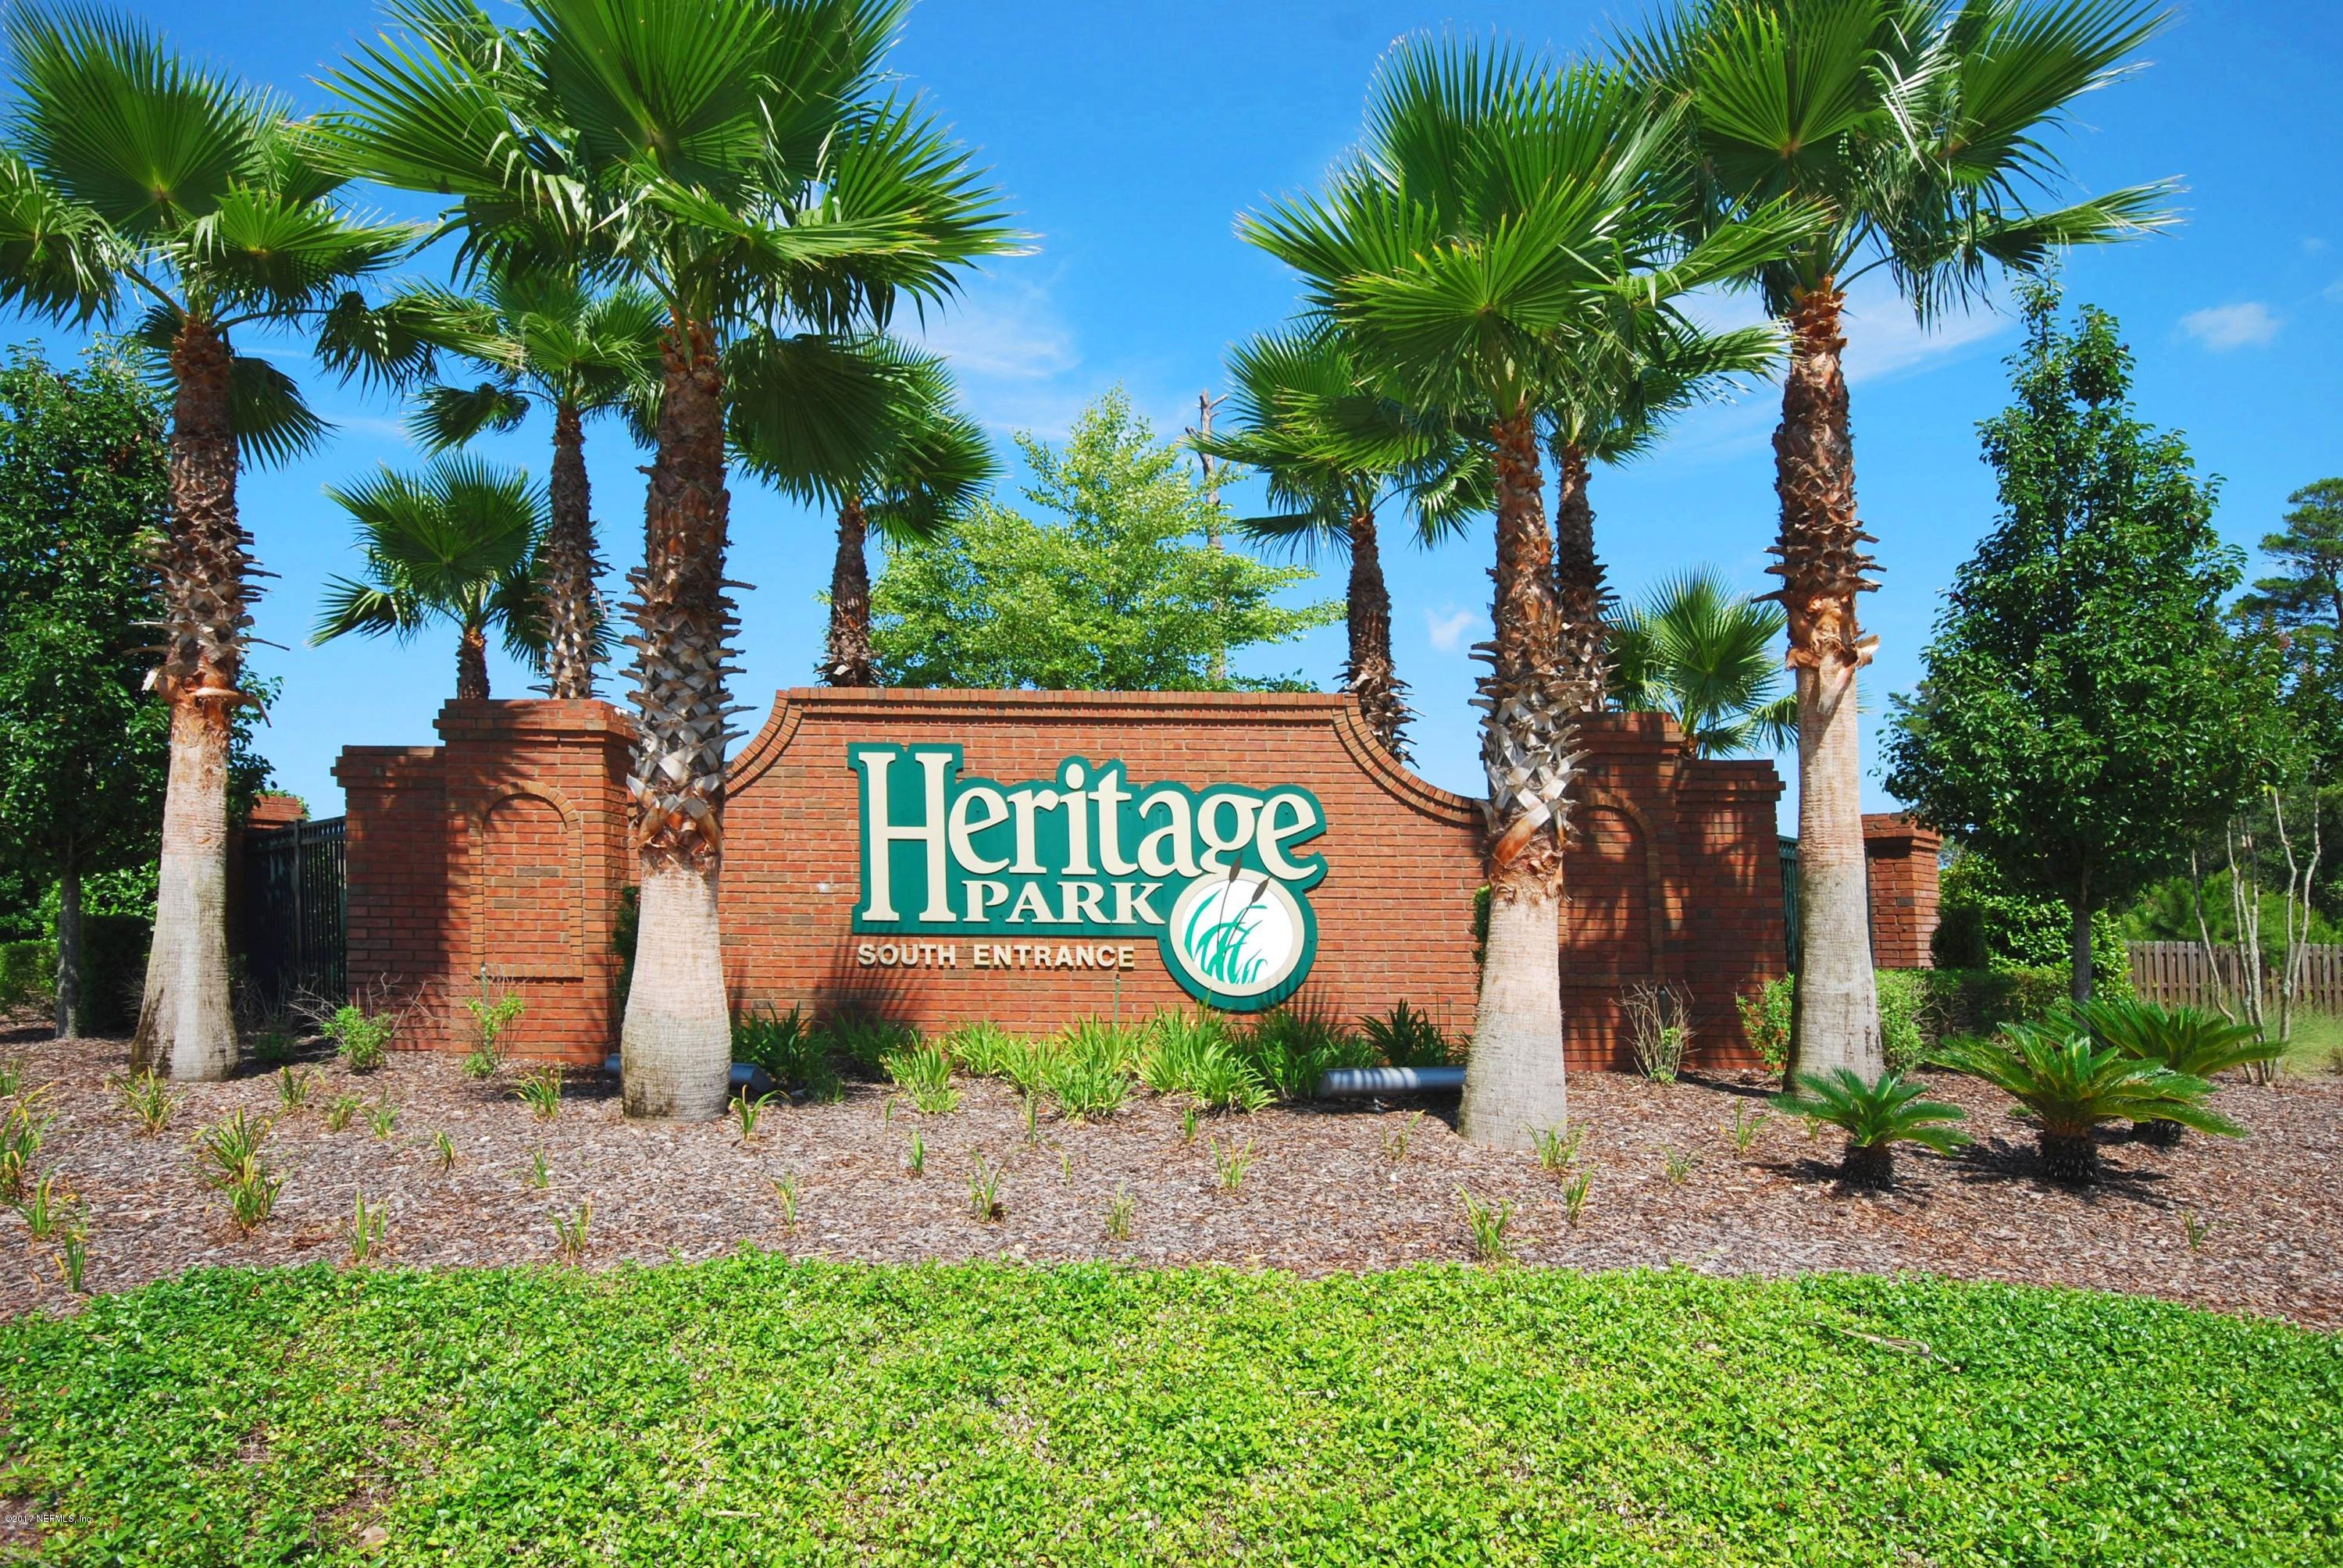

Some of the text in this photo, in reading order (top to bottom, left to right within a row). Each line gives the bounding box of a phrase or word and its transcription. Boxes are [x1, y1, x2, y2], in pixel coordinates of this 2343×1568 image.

[858, 752, 1318, 922] Heritage
[961, 880, 1166, 925] PARK
[858, 944, 1136, 968] SOUTH ENTRANCE
